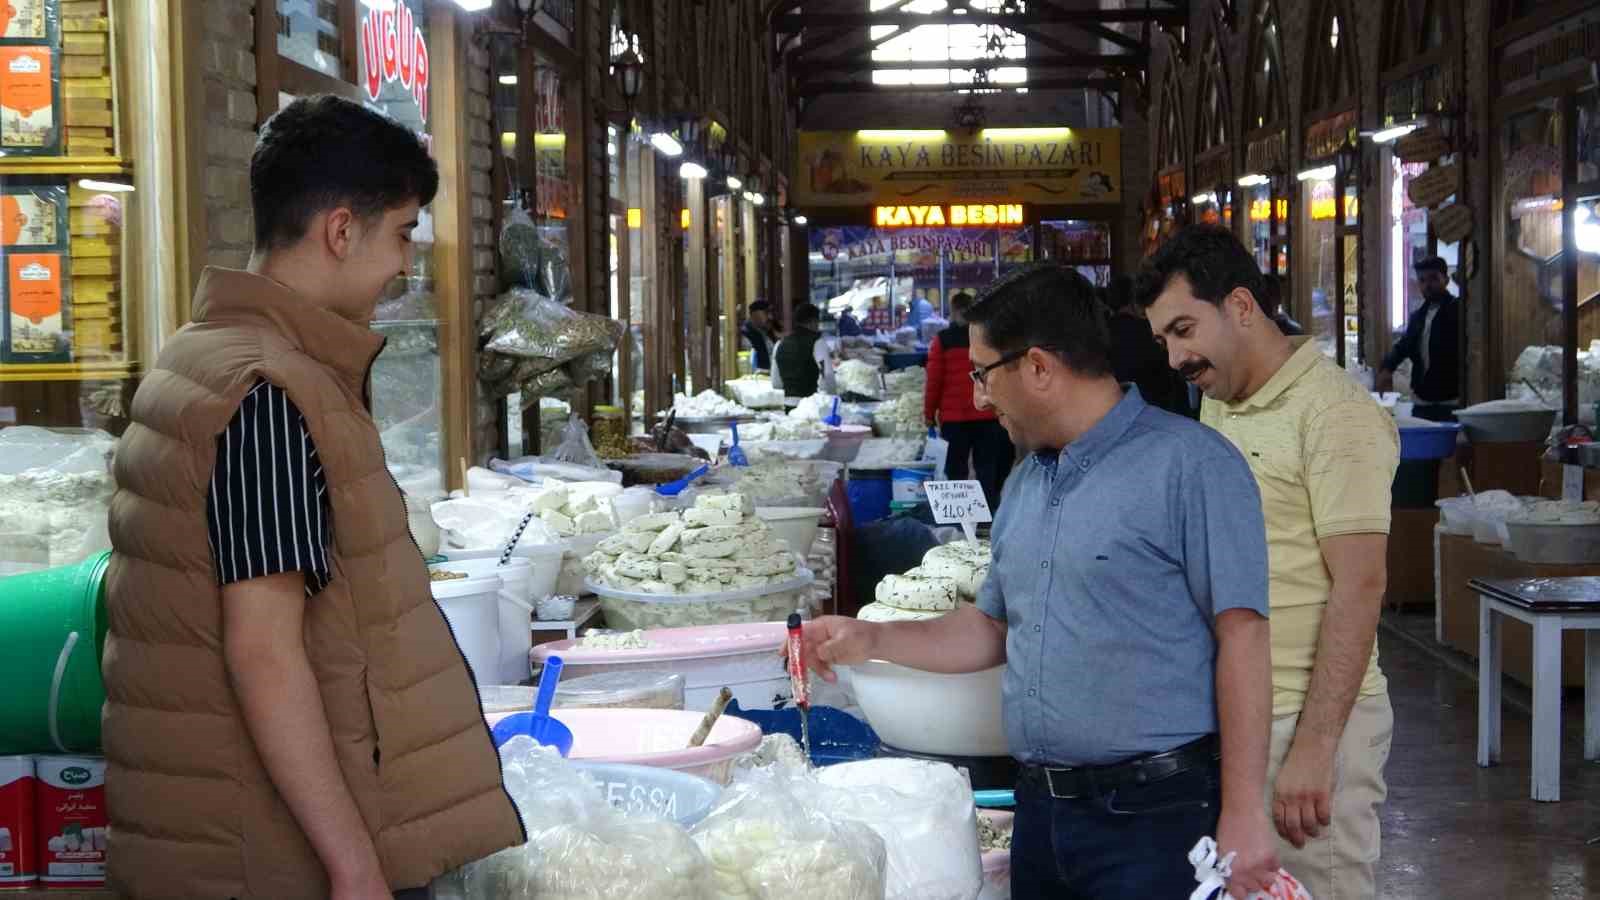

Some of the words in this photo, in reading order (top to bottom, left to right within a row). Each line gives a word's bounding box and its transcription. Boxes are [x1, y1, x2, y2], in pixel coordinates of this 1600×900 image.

[860, 142, 931, 168] KAYA
[941, 137, 1002, 166] BESİN
[1013, 142, 1102, 167] PAZARI
[876, 205, 946, 226] KAYA
